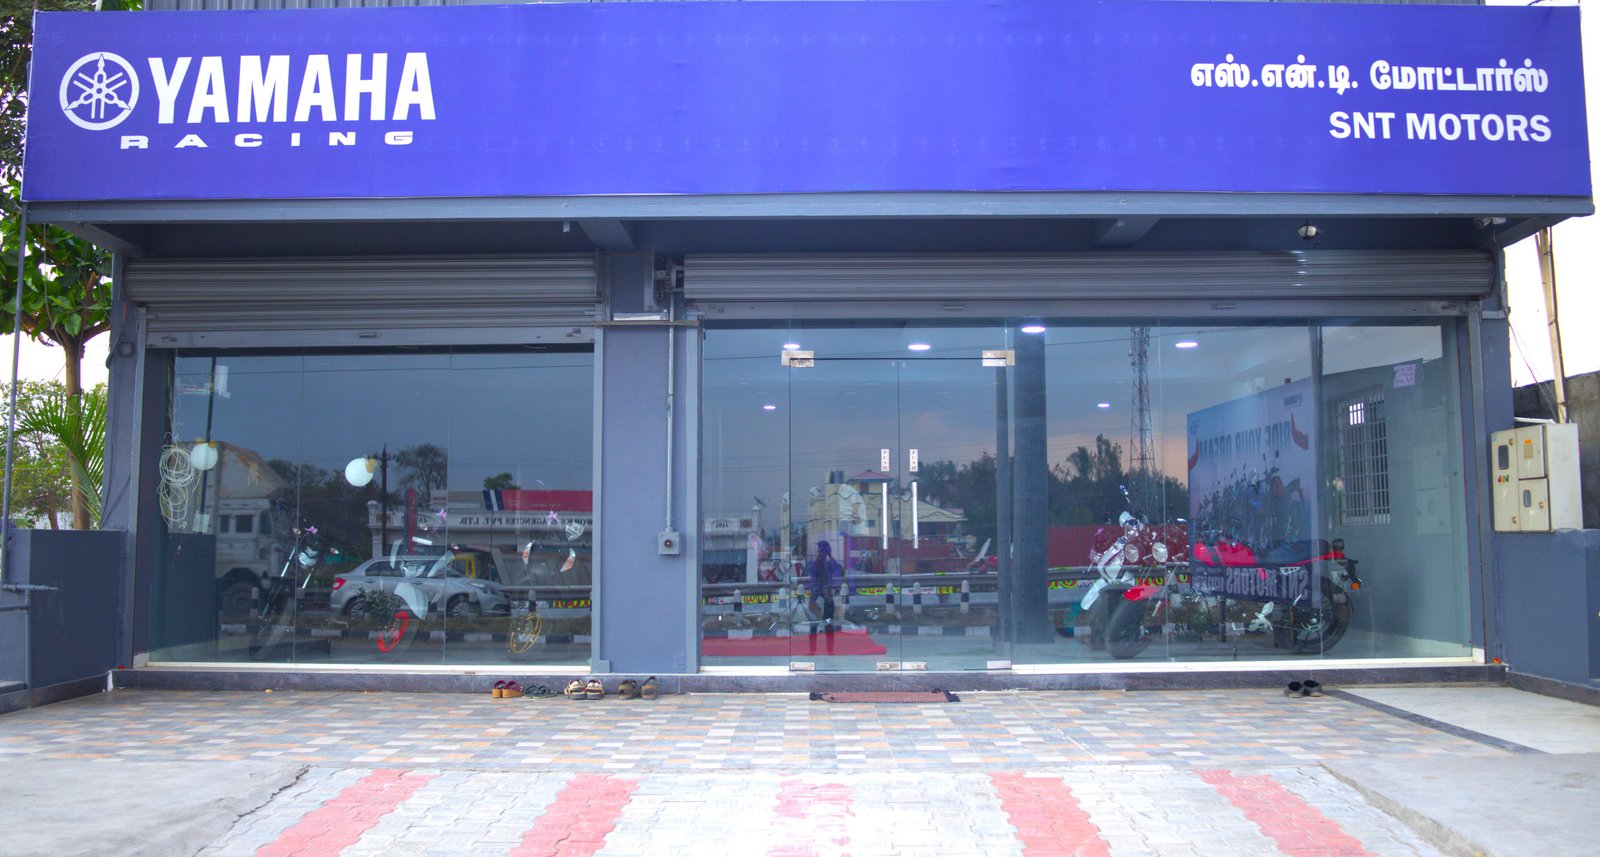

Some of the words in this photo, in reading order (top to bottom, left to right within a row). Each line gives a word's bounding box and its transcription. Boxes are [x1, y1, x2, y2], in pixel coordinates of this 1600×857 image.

[147, 52, 437, 125] YAMAHA
[1190, 53, 1359, 96] எஸ்.என்.டி.
[1369, 58, 1549, 93] மோட்டார்ஸ்
[120, 130, 414, 150] RACING
[1329, 111, 1396, 140] SNT
[1406, 112, 1552, 143] MOTORS
